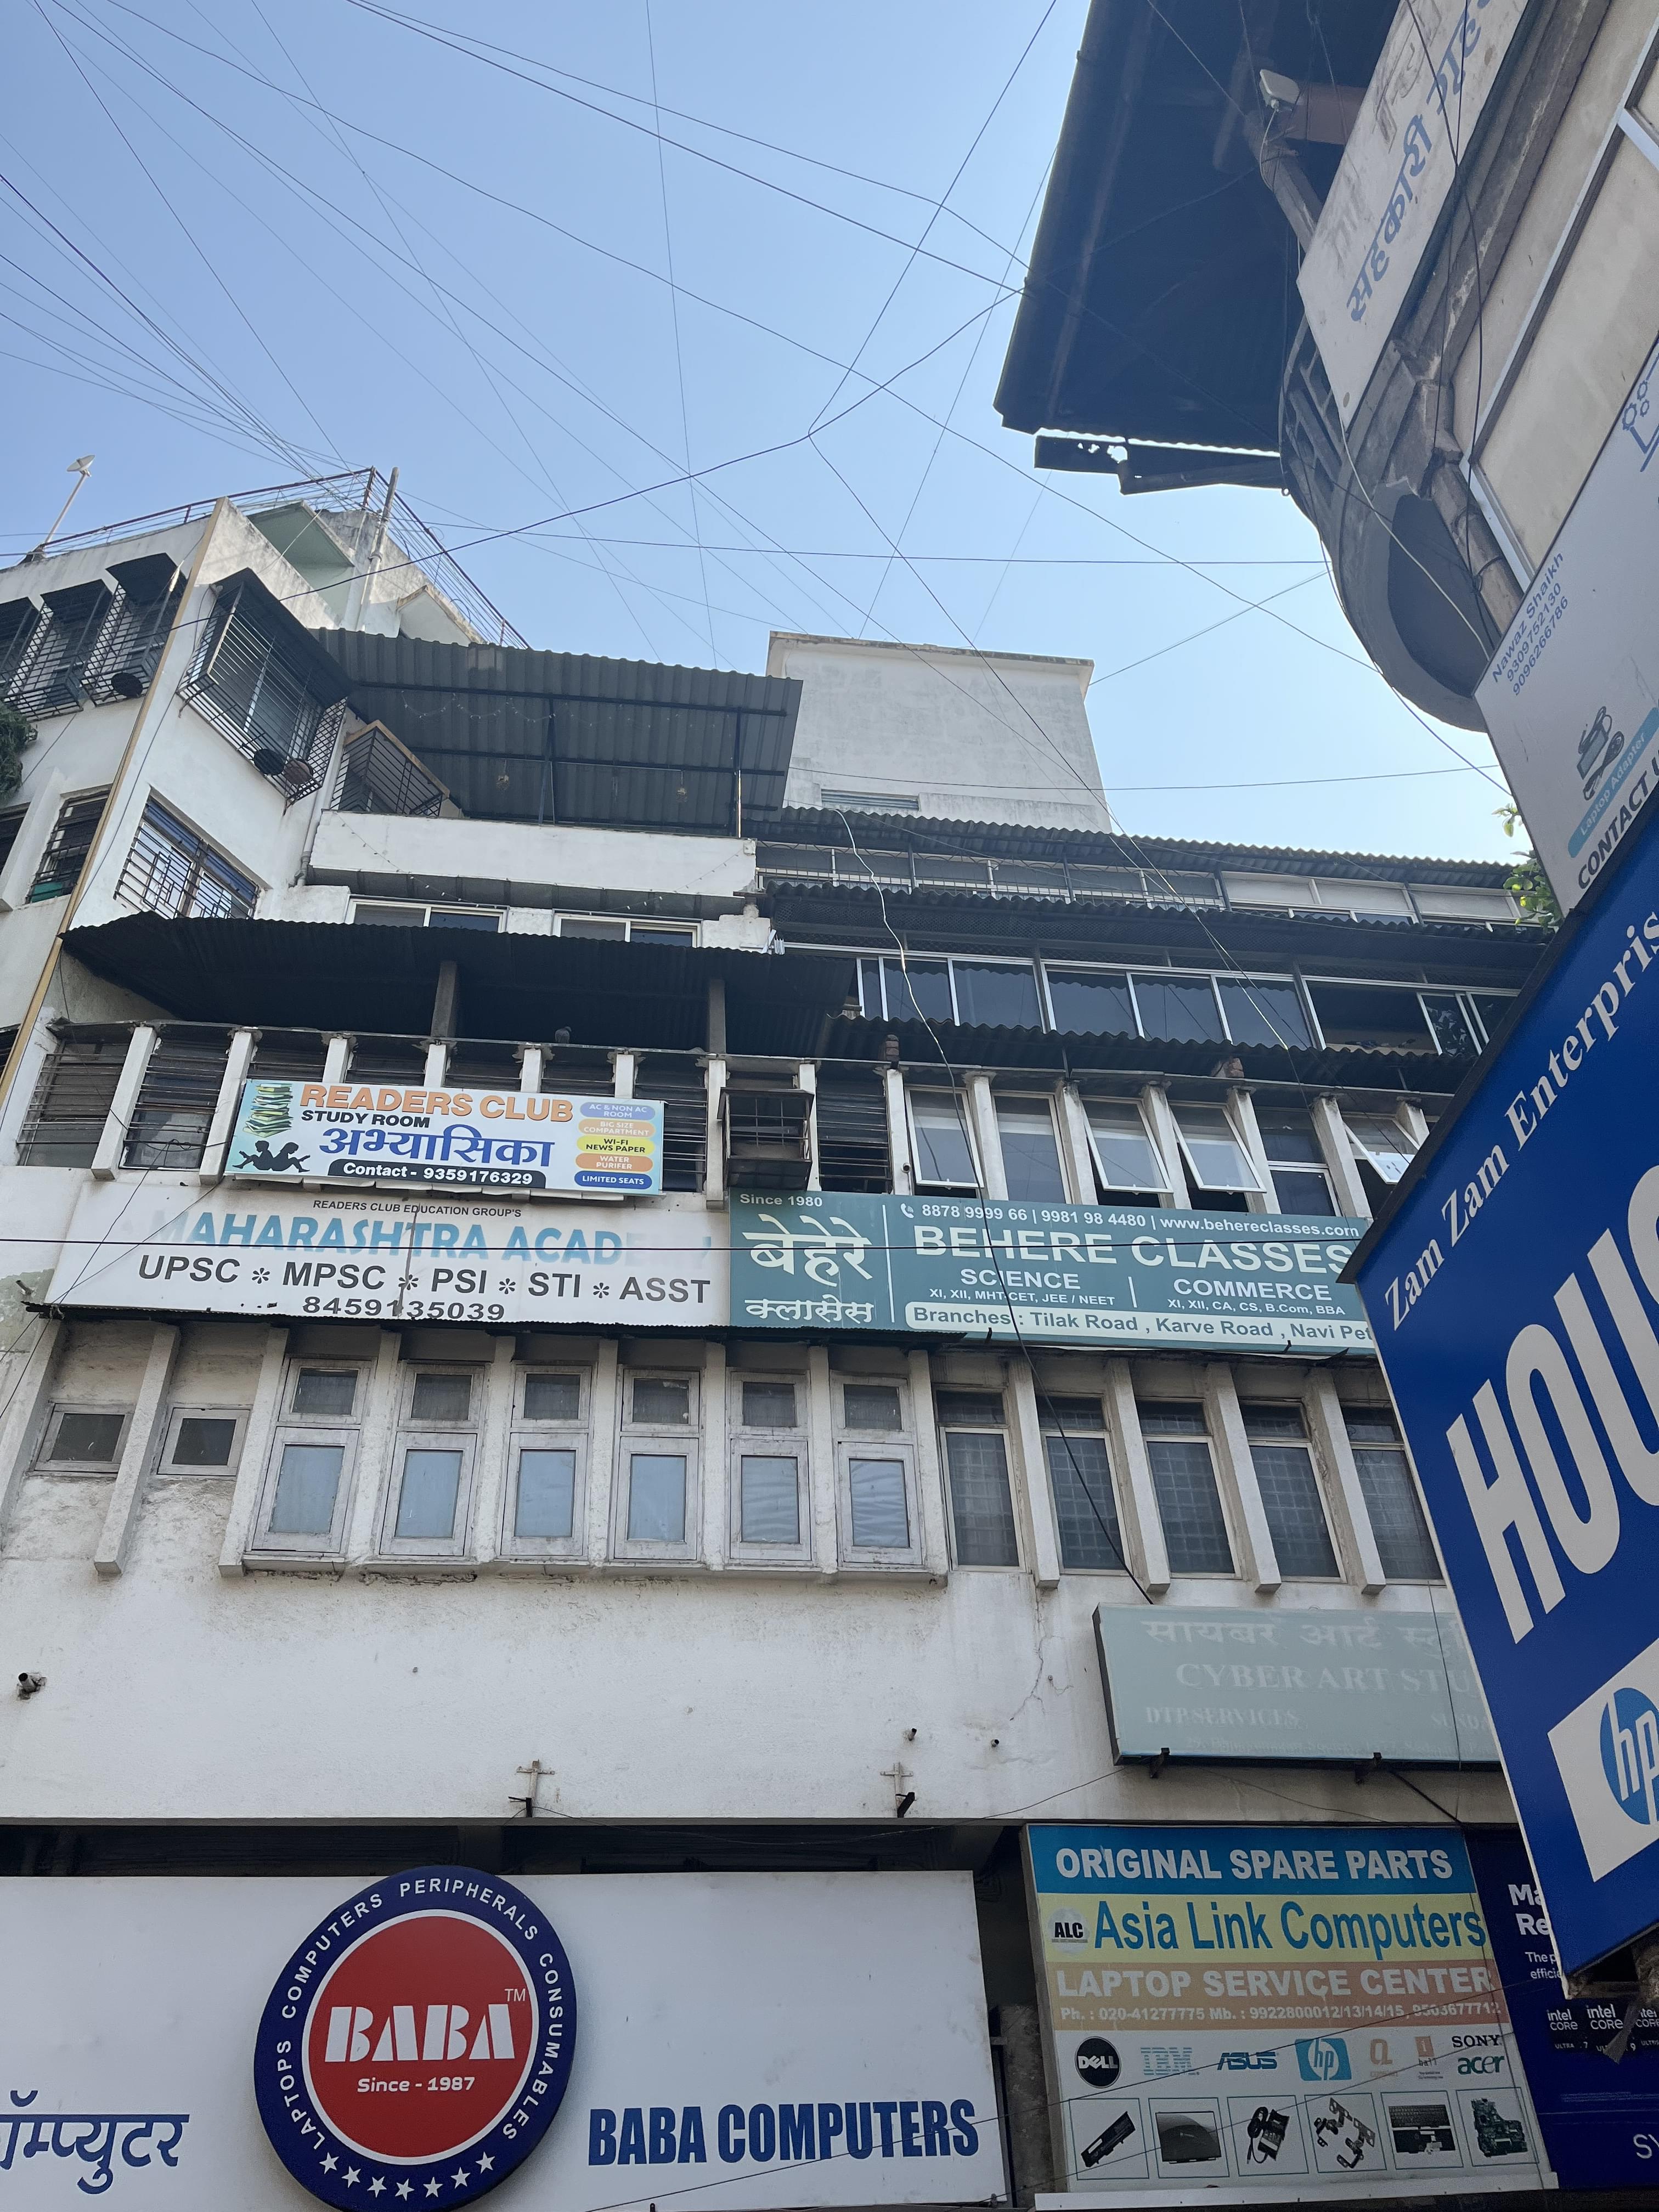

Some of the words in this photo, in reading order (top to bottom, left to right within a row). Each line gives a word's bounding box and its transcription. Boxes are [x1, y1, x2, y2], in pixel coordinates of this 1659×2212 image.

[1346, 114, 1432, 322] सहकारी
[1492, 622, 1527, 683] Nawaz
[1526, 552, 1564, 619] Shaikh
[1506, 582, 1561, 682] 9309752130
[1513, 595, 1568, 696] 9096266786
[1580, 789, 1611, 836] Laptop
[1578, 770, 1649, 890] CONTACT
[300, 1084, 473, 1117] READERS
[479, 1095, 574, 1123] CLUB
[301, 1109, 369, 1124] STUDY
[371, 1114, 430, 1128] ROOM
[319, 1124, 555, 1167] अभ्यासिका
[583, 1127, 650, 1136] COMPARTMENT
[343, 1162, 407, 1178] Contact
[422, 1166, 533, 1186] 9359176329
[582, 1175, 617, 1184] LIMITED
[618, 1177, 645, 1186] SEATS
[313, 1200, 368, 1211] READERS
[370, 1203, 400, 1212] CLUB
[403, 1204, 469, 1216] EDUCATION
[472, 1207, 522, 1218] GROUP'S
[740, 1193, 783, 1206] Since
[788, 1195, 823, 1207] 1980
[922, 1204, 961, 1218] 8878
[965, 1206, 1003, 1220] 9999
[1008, 1208, 1028, 1221] 66
[1041, 1209, 1079, 1224] 9981
[1083, 1211, 1104, 1226] 98
[1107, 1212, 1147, 1227] 4480
[1159, 1217, 1360, 1238] www.behereclasses.com
[1385, 1239, 1444, 1331] Zam
[1442, 1144, 1510, 1248] Zam
[742, 1213, 873, 1288] बेहेरे
[913, 1224, 1118, 1265] BEHERE
[1130, 1235, 1353, 1274] CLASSES
[138, 1254, 240, 1284] UPSC
[283, 1261, 386, 1290] MPSC
[431, 1267, 487, 1295] PSI
[528, 1271, 581, 1299] STI
[619, 1276, 711, 1304] ASST
[961, 1268, 1081, 1290] SCIENCE
[1173, 1278, 1333, 1302] COMMERCE
[302, 1295, 505, 1321] 8459135039
[929, 1288, 946, 1300] XI,
[950, 1289, 971, 1301] XII,
[1041, 1293, 1069, 1304] JEE
[1079, 1294, 1116, 1306] NEET
[1167, 1298, 1186, 1310] XI,
[1188, 1299, 1210, 1311] XII,
[1212, 1301, 1236, 1313] CA,
[1239, 1302, 1262, 1313] CS,
[1265, 1303, 1313, 1316] B.Com,
[1315, 1305, 1346, 1316] BBA
[913, 1306, 1012, 1325] Branches
[1030, 1311, 1080, 1328] Tilak
[1085, 1314, 1138, 1331] Road
[1155, 1317, 1215, 1334] Karve
[1220, 1320, 1274, 1337] Road
[1290, 1323, 1335, 1339] Navi
[1175, 1662, 1309, 1691] CYBER
[1318, 1666, 1391, 1693] ART
[1056, 1847, 1222, 1879] ORIGINAL
[1229, 1849, 1339, 1880] SPARE
[1345, 1848, 1453, 1880] PARTS
[399, 1877, 538, 1941] PERIPHERALS
[1054, 1921, 1084, 1939] ALC
[1094, 1900, 1180, 1950] Asia
[1186, 1901, 1273, 1950] Link
[1280, 1900, 1487, 1961] Computers
[281, 1893, 383, 2019] COMPUTERS
[1525, 1951, 1548, 1963] The
[1056, 1970, 1192, 1997] LAPTOP
[1202, 1970, 1352, 1997] SERVICE
[1359, 1966, 1497, 1996] CENTER
[324, 2003, 515, 2062] BABA
[504, 1988, 527, 2002] TM
[1098, 2007, 1205, 2021] 020-41277775
[1546, 2008, 1572, 2021] intel
[1585, 2003, 1616, 2019] intel
[502, 1953, 563, 2140] CONSUMABLES
[1451, 2034, 1500, 2048] SONY
[1077, 2055, 1119, 2070] DELL
[1141, 2047, 1199, 2076] IBM
[1217, 2051, 1278, 2070] ASUS
[1457, 2056, 1505, 2075] acer
[276, 2040, 326, 2150] LAPTOPS
[357, 2077, 410, 2093] Since
[427, 2076, 476, 2092] 1987
[0, 2090, 190, 2195] ॉम्प्युटर
[588, 2106, 707, 2166] BABA
[718, 2099, 979, 2163] COMPUTERS
